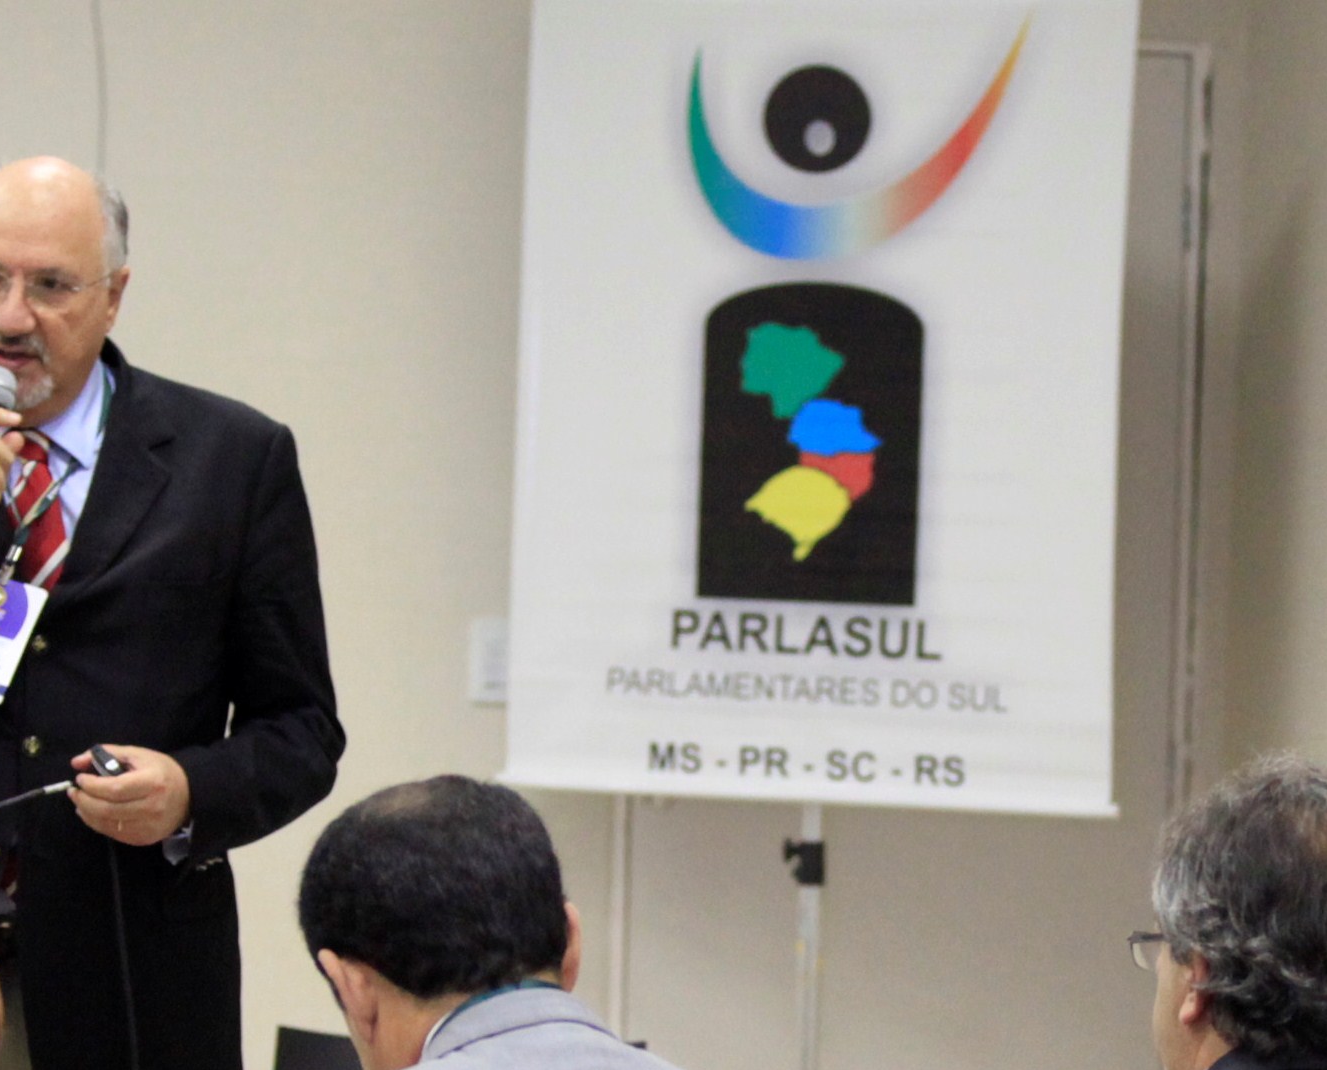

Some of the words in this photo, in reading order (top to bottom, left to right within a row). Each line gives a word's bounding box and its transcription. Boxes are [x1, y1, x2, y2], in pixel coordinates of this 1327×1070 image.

[670, 608, 942, 661] PARLASUL
[606, 666, 881, 708] PARLAMENTARES
[890, 678, 939, 710] DO
[947, 682, 1008, 713] SUL
[647, 742, 702, 773] MS
[738, 746, 790, 777] PR
[825, 750, 876, 782] SC
[913, 754, 966, 787] RS
